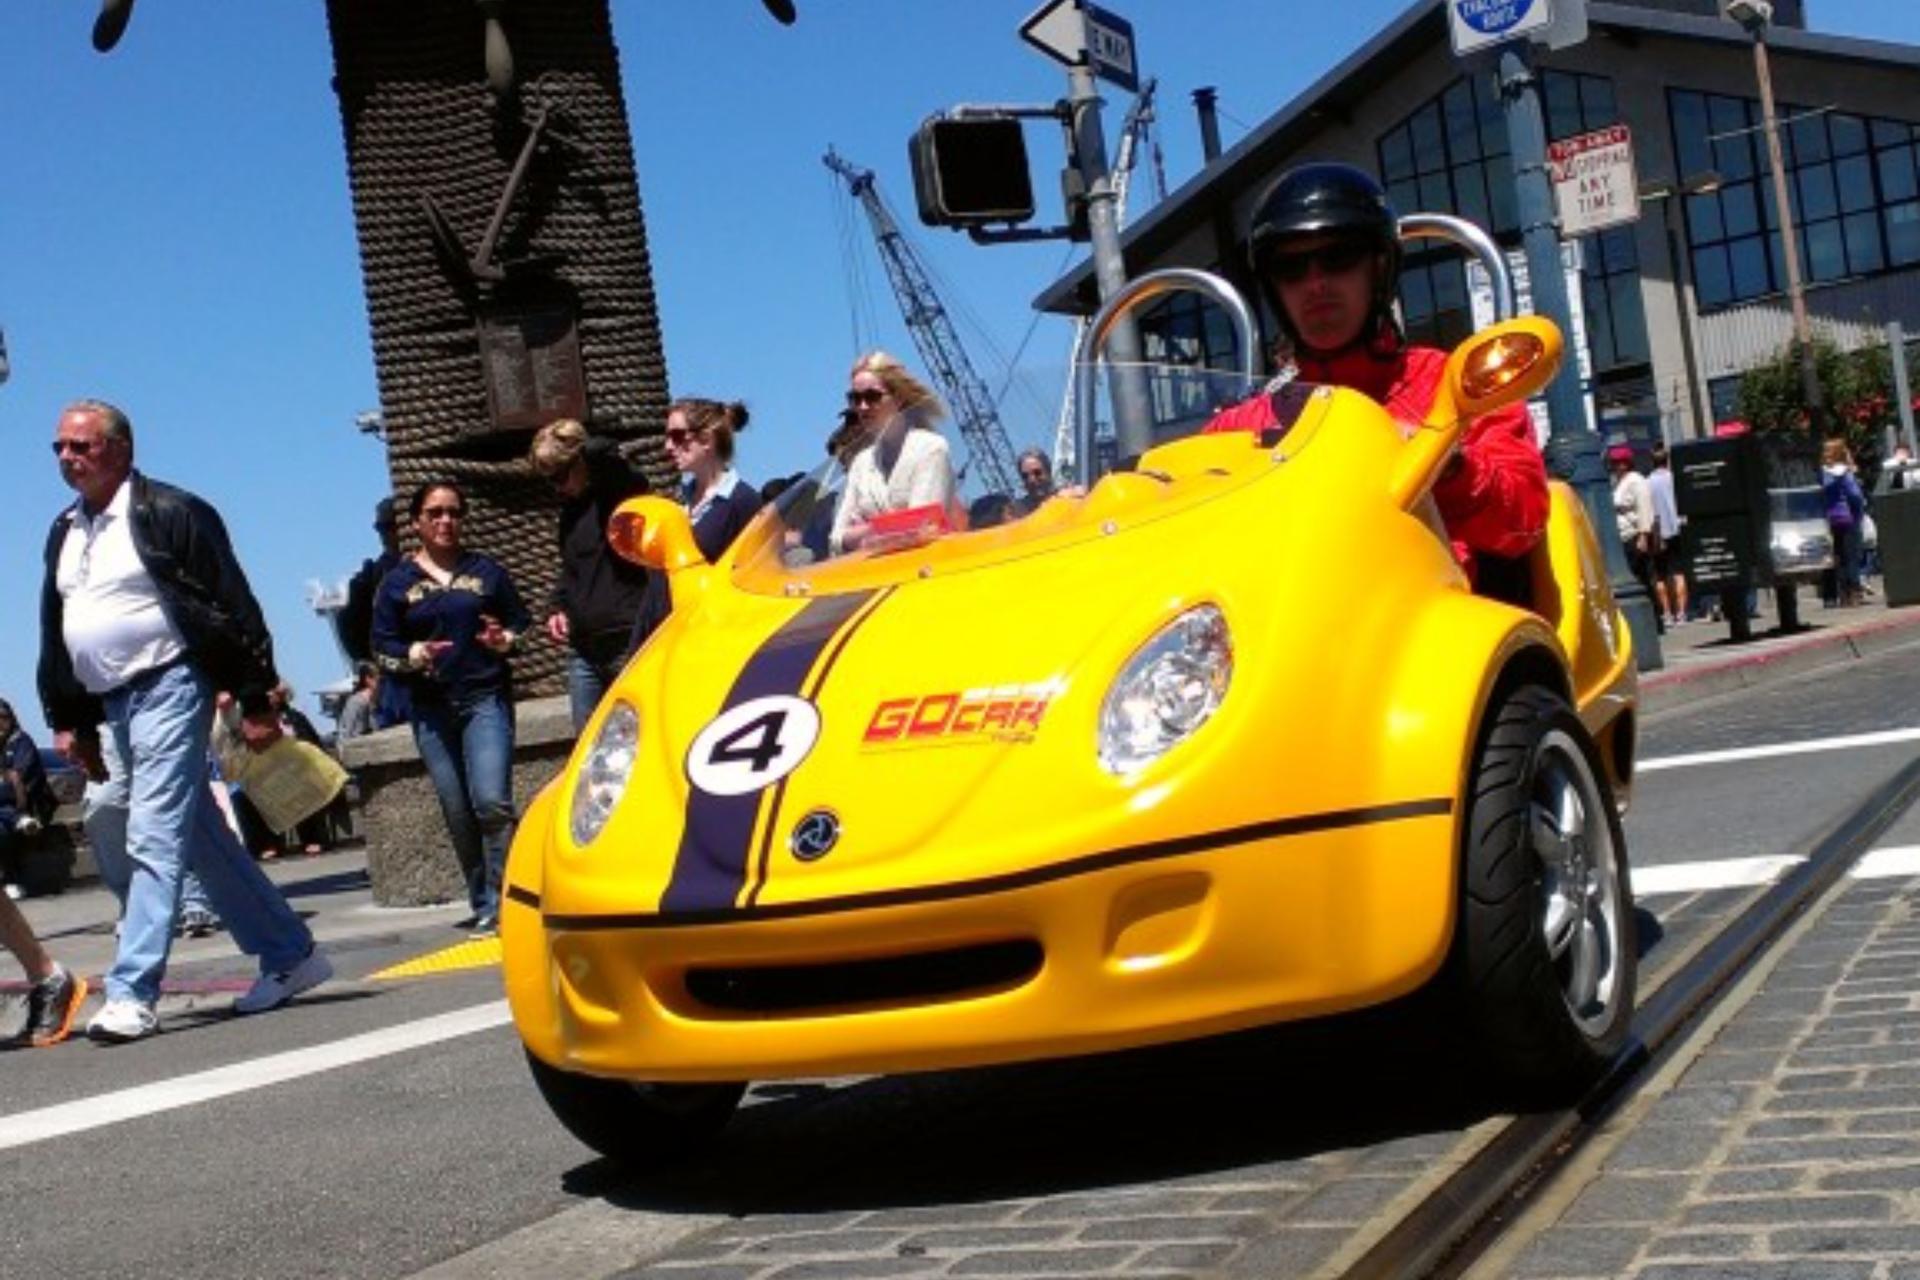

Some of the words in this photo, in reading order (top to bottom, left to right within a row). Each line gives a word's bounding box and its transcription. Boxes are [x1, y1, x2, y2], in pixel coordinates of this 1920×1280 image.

[1580, 172, 1610, 194] ANY
[1577, 192, 1616, 214] TIME
[707, 709, 788, 772] 4
